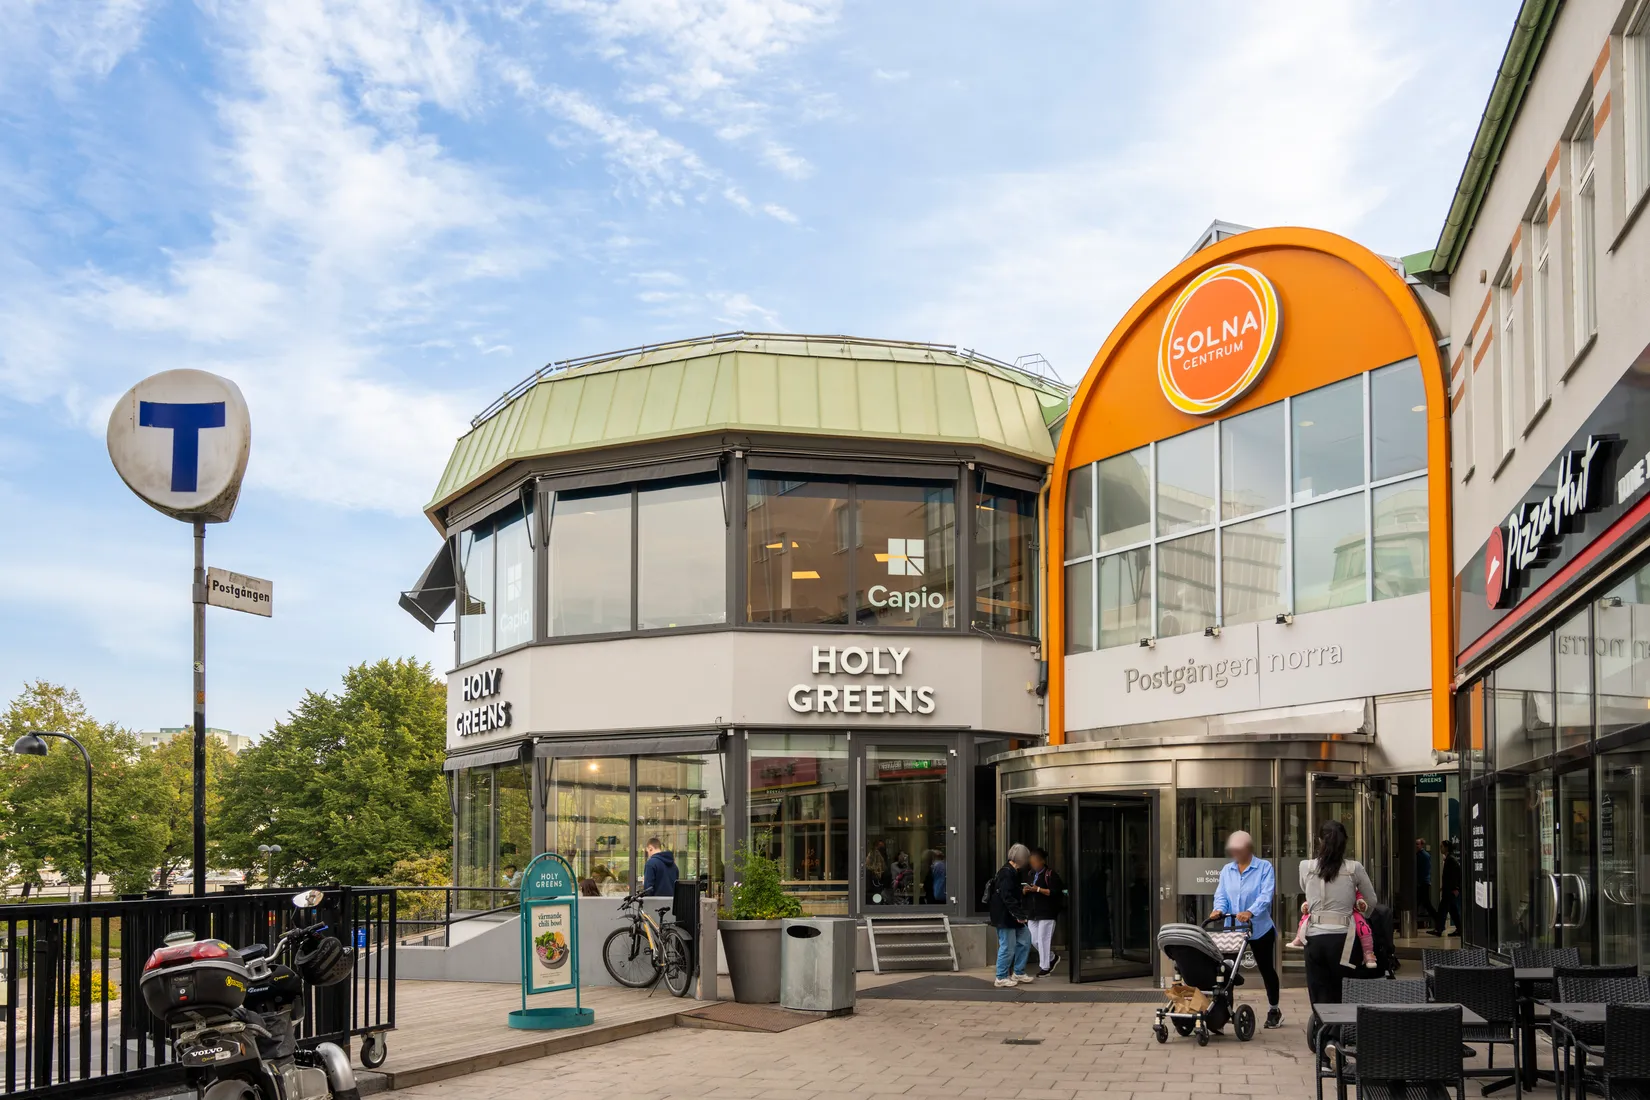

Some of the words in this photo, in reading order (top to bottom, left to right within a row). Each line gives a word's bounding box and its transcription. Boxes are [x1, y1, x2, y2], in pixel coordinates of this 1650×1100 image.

[1173, 310, 1258, 360] SOLNA
[1183, 340, 1243, 370] CENTRUM
[140, 401, 225, 492] T
[1505, 496, 1551, 589] Pizza
[1552, 434, 1600, 536] Hut
[212, 579, 270, 603] Postgången
[867, 586, 944, 613] Capio
[500, 610, 530, 634] Capio
[811, 646, 910, 676] HOLY
[1124, 657, 1260, 695] Postgången
[1267, 645, 1343, 672] norra
[462, 668, 499, 702] HOLY
[787, 684, 937, 714] GREENS
[454, 702, 508, 737] GREENS
[535, 880, 563, 888] GREENS
[540, 872, 559, 880] HOLY
[538, 919, 550, 927] chili
[550, 918, 562, 926] bowl
[190, 1046, 223, 1057] VOLVO
